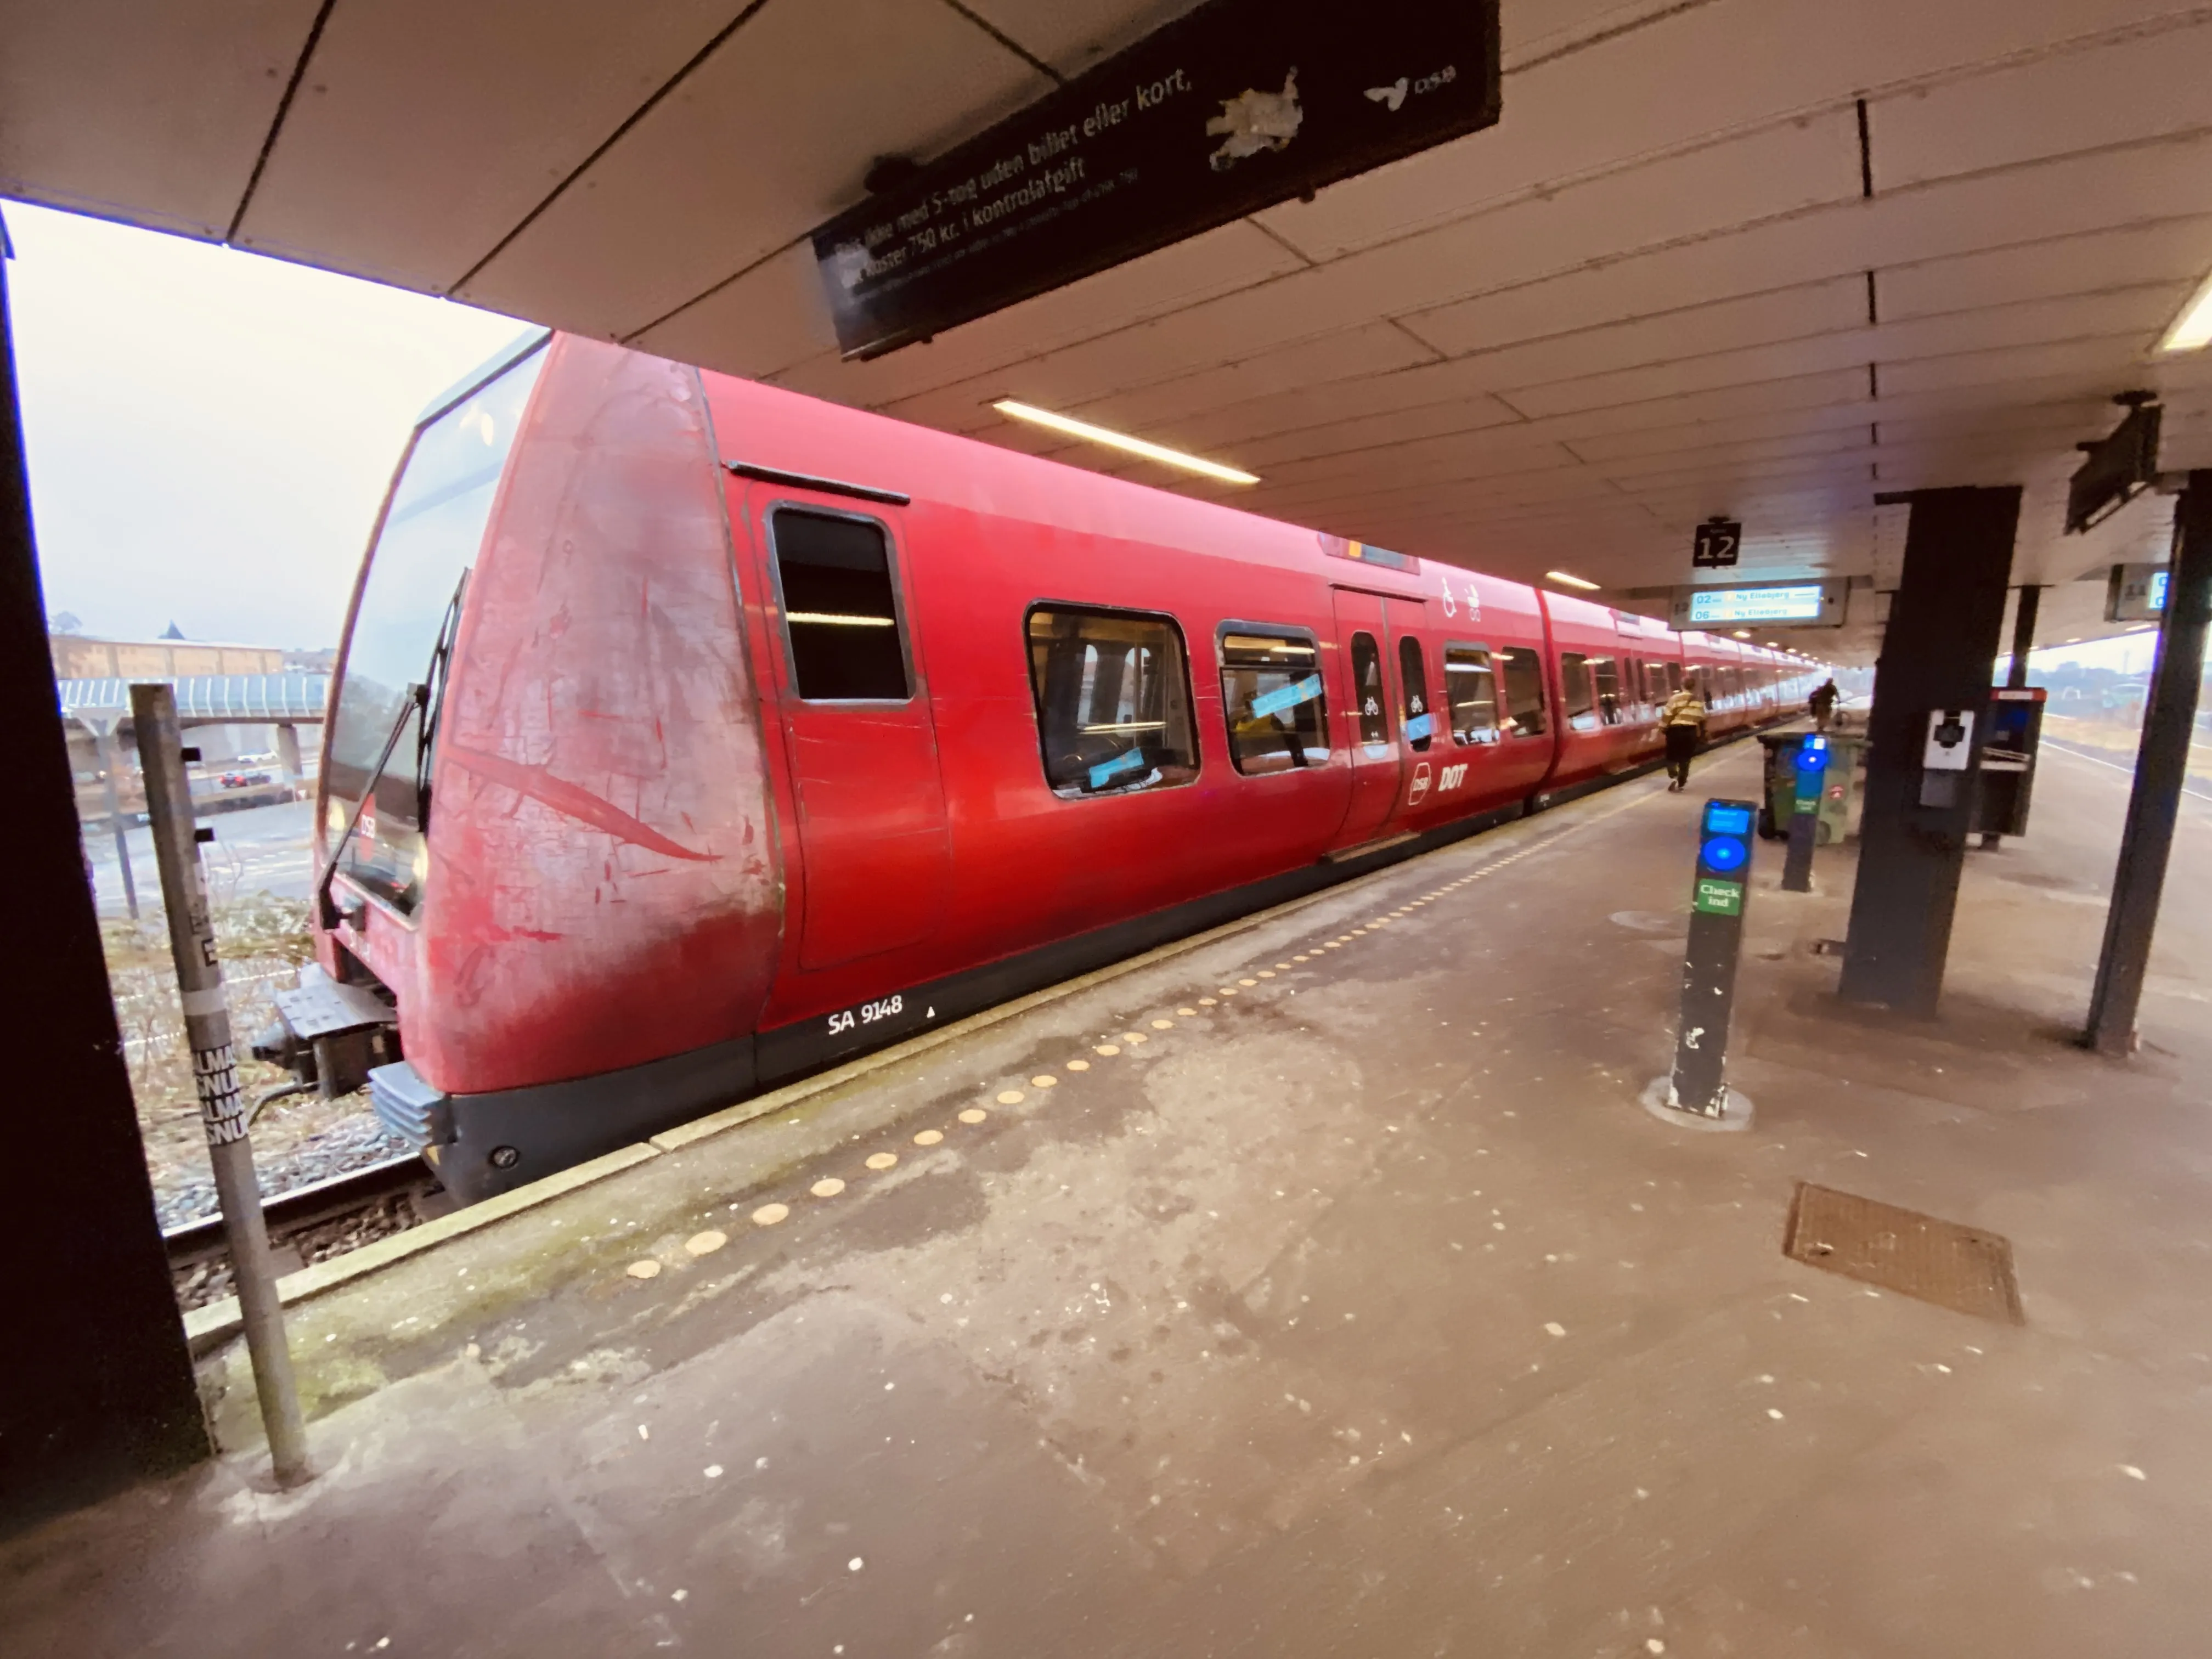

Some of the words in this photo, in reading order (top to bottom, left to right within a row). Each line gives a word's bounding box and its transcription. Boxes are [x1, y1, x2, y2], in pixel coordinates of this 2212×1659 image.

[980, 156, 1024, 189] uden
[1028, 124, 1078, 165] billet
[1083, 99, 1130, 137] eller
[1136, 69, 1193, 111] kort,
[1697, 535, 1735, 560] 12
[1696, 595, 1712, 604] 02
[1735, 592, 1748, 602] Ny
[1695, 611, 1710, 619] 06
[1734, 610, 1746, 618] Ny
[1413, 777, 1429, 791] DSB
[1438, 763, 1469, 792] DOT
[362, 814, 375, 838] DSB
[1701, 884, 1740, 898] Check
[1708, 896, 1729, 907] ind
[828, 1011, 855, 1035] SA
[861, 995, 903, 1024] 9148
